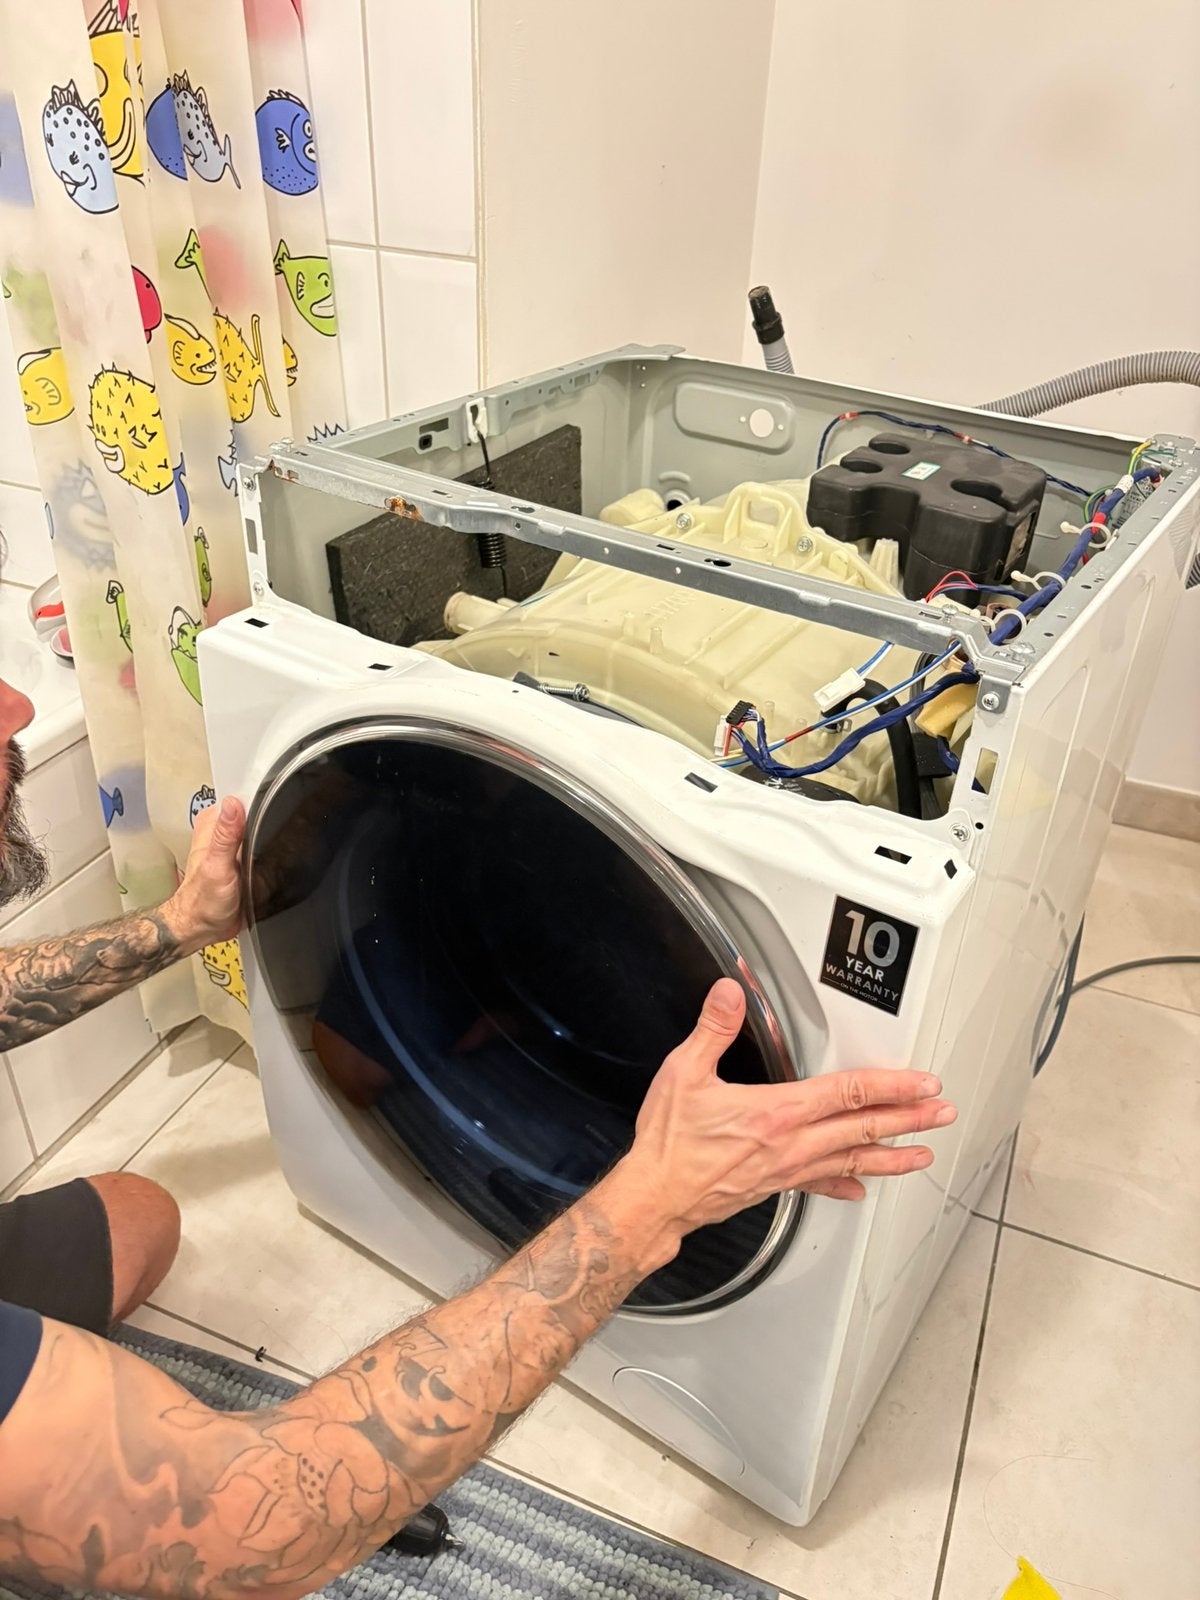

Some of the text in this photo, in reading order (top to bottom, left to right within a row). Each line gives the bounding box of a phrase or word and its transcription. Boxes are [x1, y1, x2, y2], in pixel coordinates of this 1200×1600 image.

[845, 909, 900, 967] 10
[825, 962, 899, 1001] WARRANTY
[845, 955, 885, 982] YEAR
